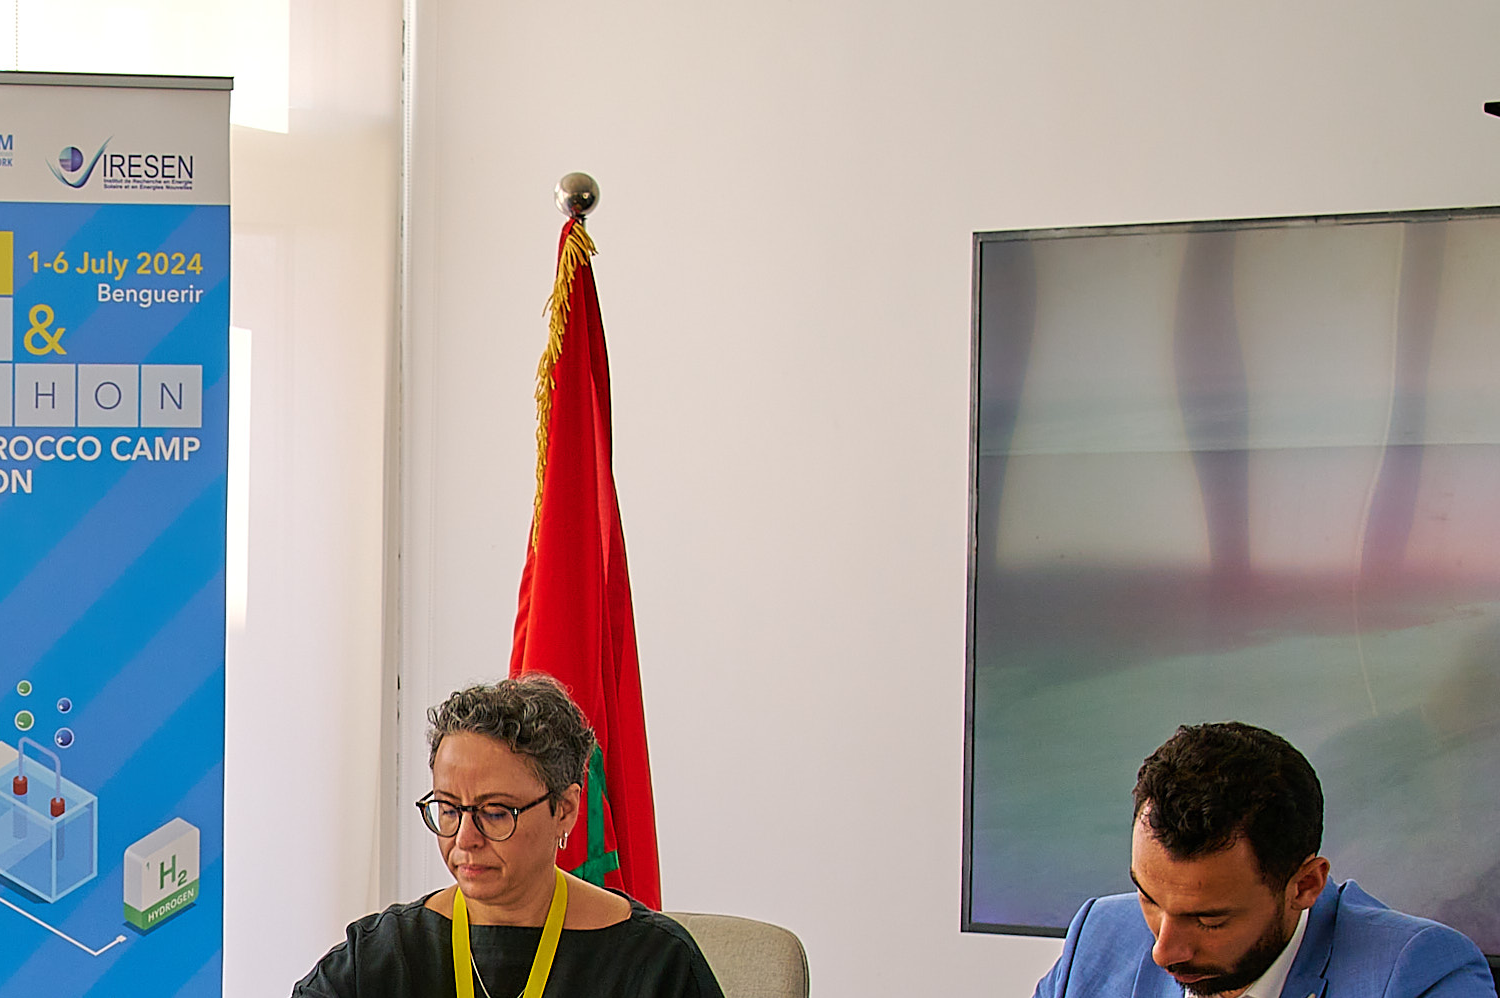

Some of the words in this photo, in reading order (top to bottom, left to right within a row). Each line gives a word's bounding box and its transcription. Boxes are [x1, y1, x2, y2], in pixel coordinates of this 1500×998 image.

[103, 154, 193, 178] IRESEN
[27, 251, 69, 274] 1-6
[76, 251, 128, 280] July
[136, 252, 203, 275] 2024
[97, 283, 203, 308] Benguerir
[23, 304, 67, 356] &
[110, 436, 201, 462] CAMP
[148, 888, 195, 922] HYDROGEN
